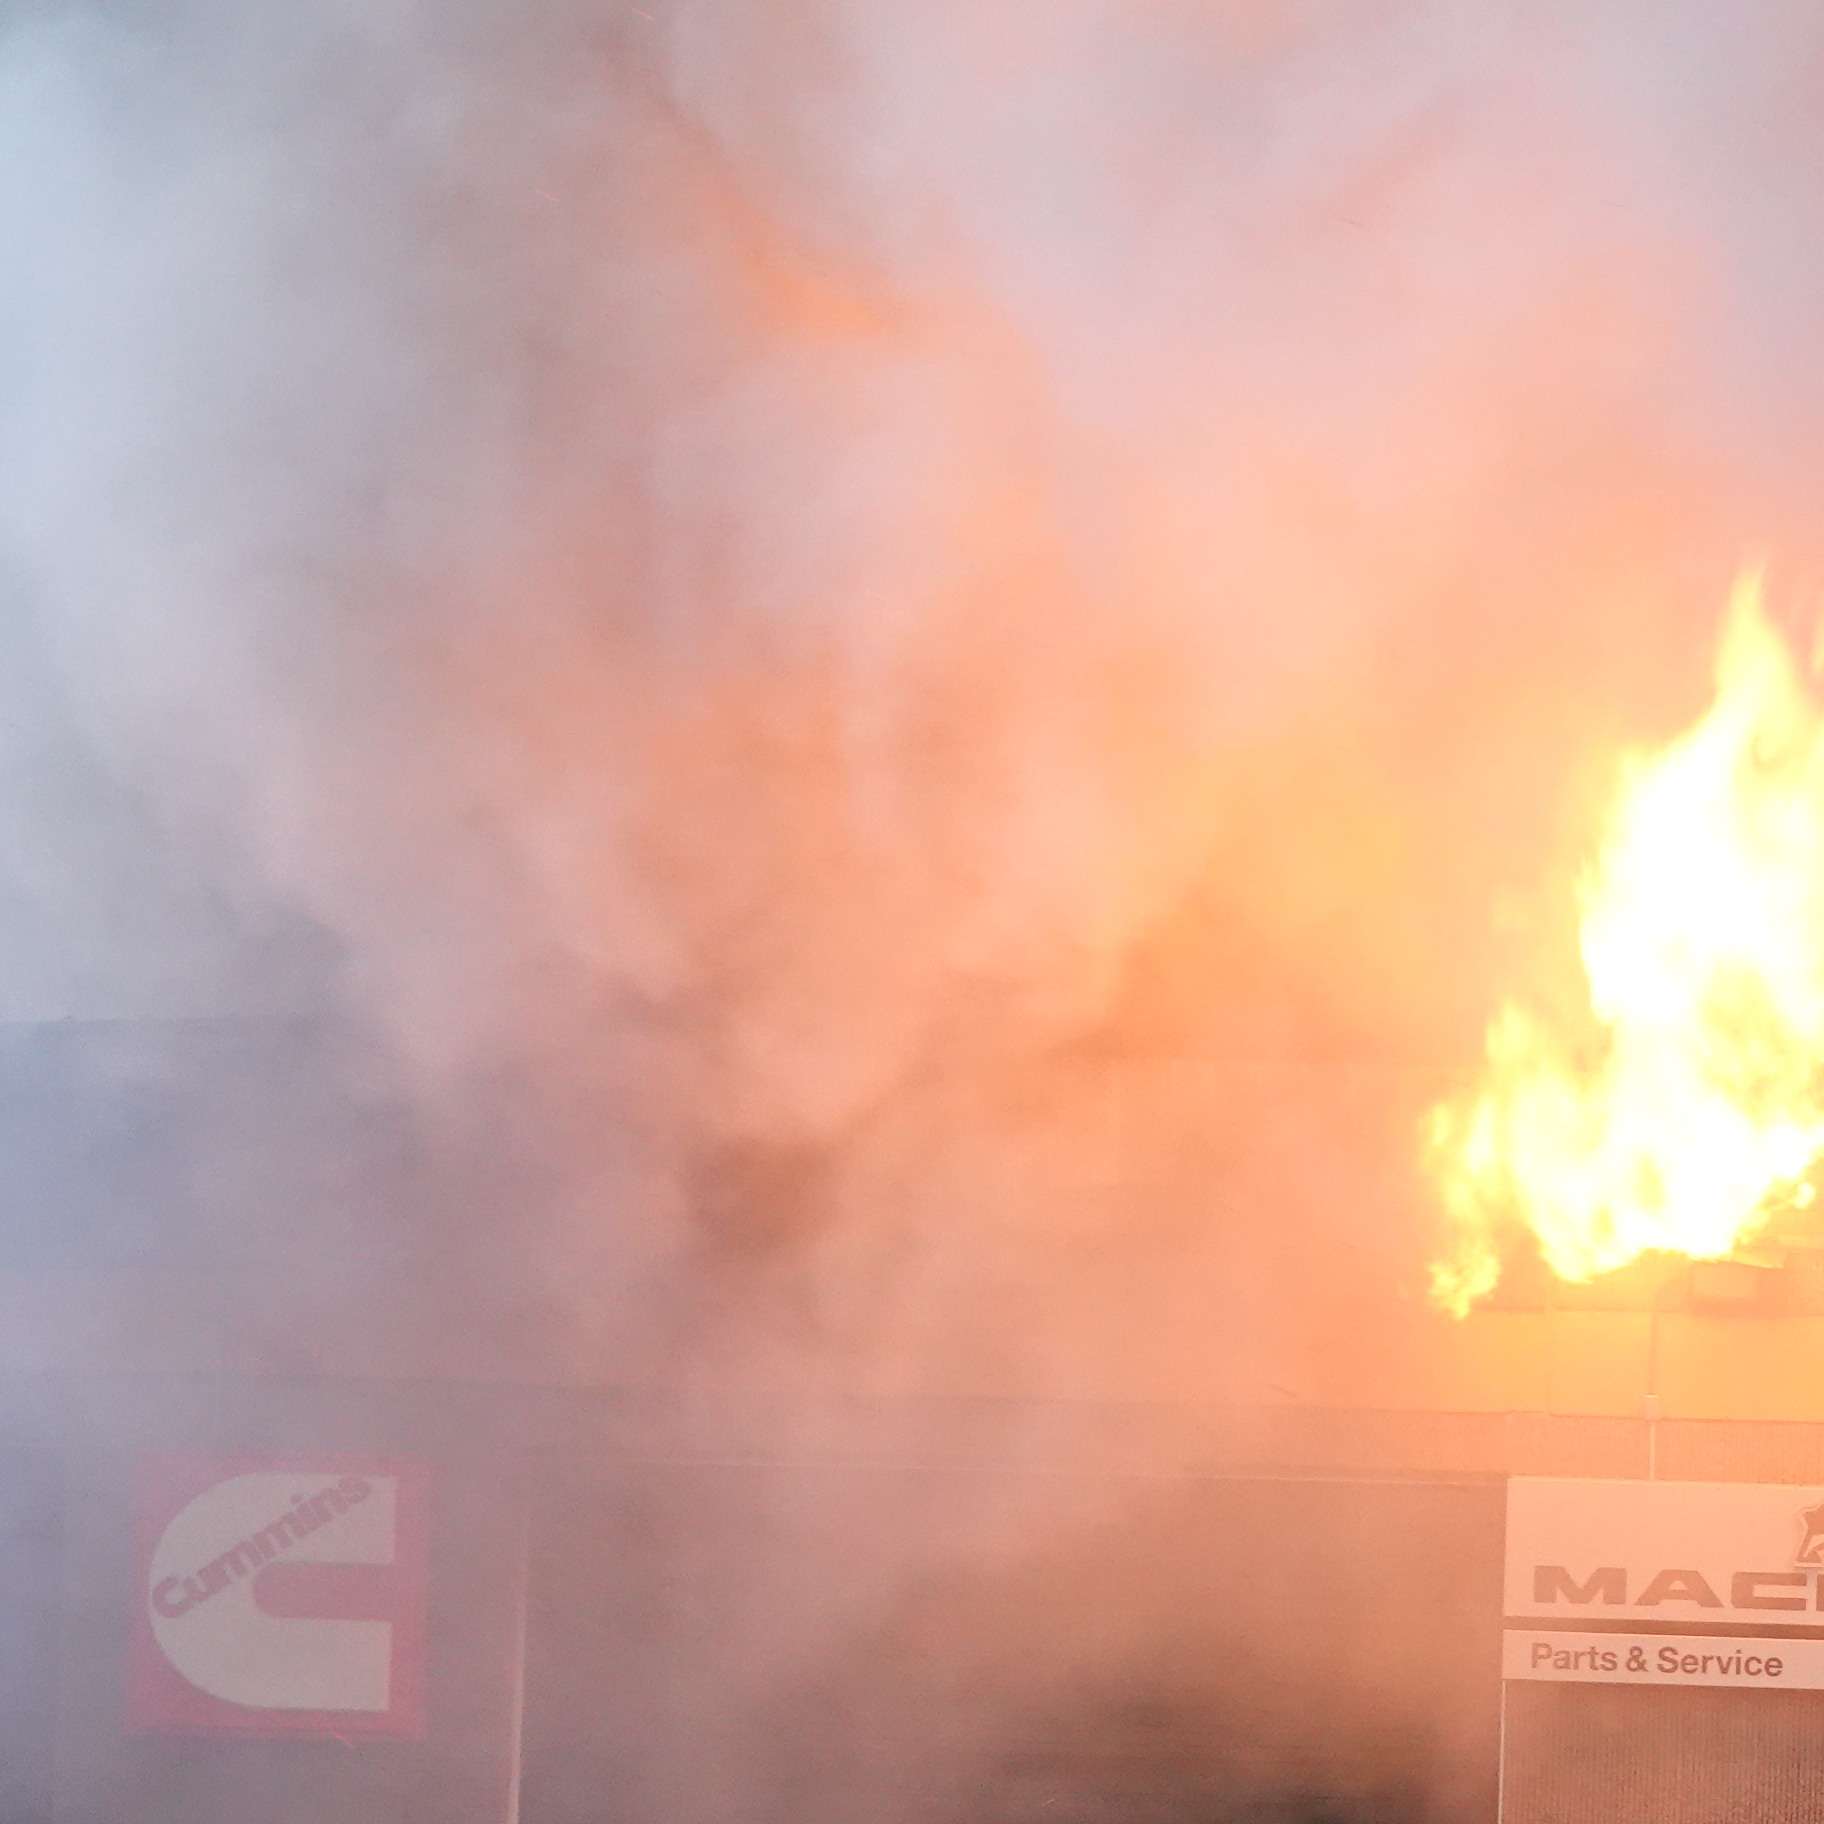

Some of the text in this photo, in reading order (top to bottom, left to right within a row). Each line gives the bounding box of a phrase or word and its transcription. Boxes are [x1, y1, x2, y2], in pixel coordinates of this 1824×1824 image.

[152, 1475, 373, 1620] Cummins
[1531, 1642, 1784, 1677] Parts & Service
